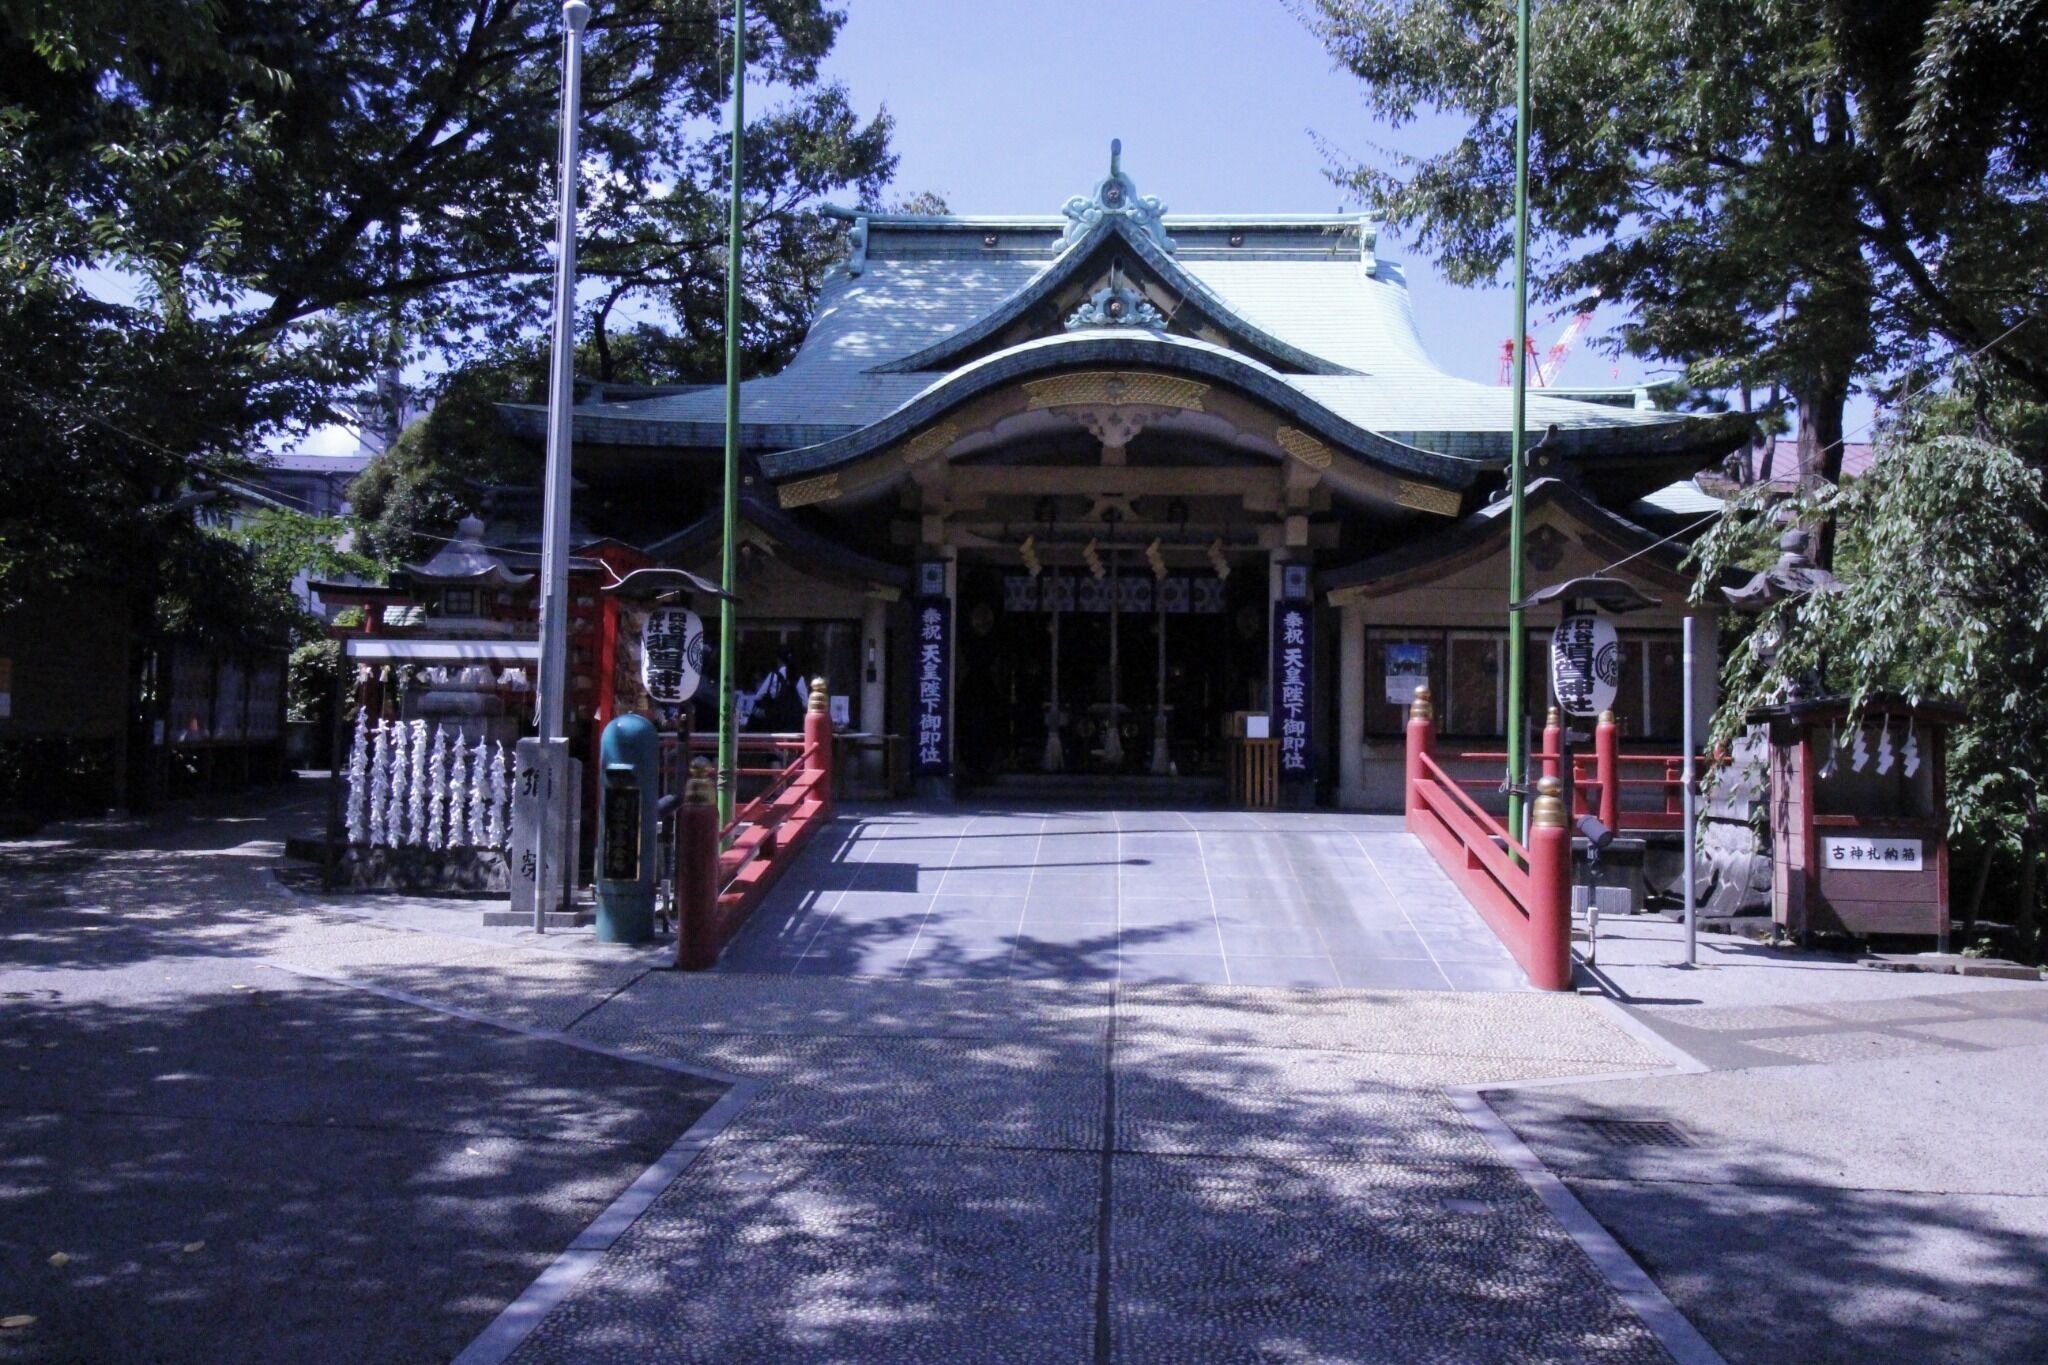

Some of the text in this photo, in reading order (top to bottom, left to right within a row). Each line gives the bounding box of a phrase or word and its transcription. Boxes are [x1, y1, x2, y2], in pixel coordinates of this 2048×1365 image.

[668, 611, 687, 633] 四谷
[1574, 619, 1594, 642] 四谷
[647, 634, 687, 699] 須賀神社
[919, 607, 942, 764] 奉祝 天皇陛下御即位
[1282, 611, 1306, 769] 奉祝 天皇陛下御即位
[1555, 643, 1595, 712] 須賀神社
[1832, 845, 1916, 861] 古神札納箱
